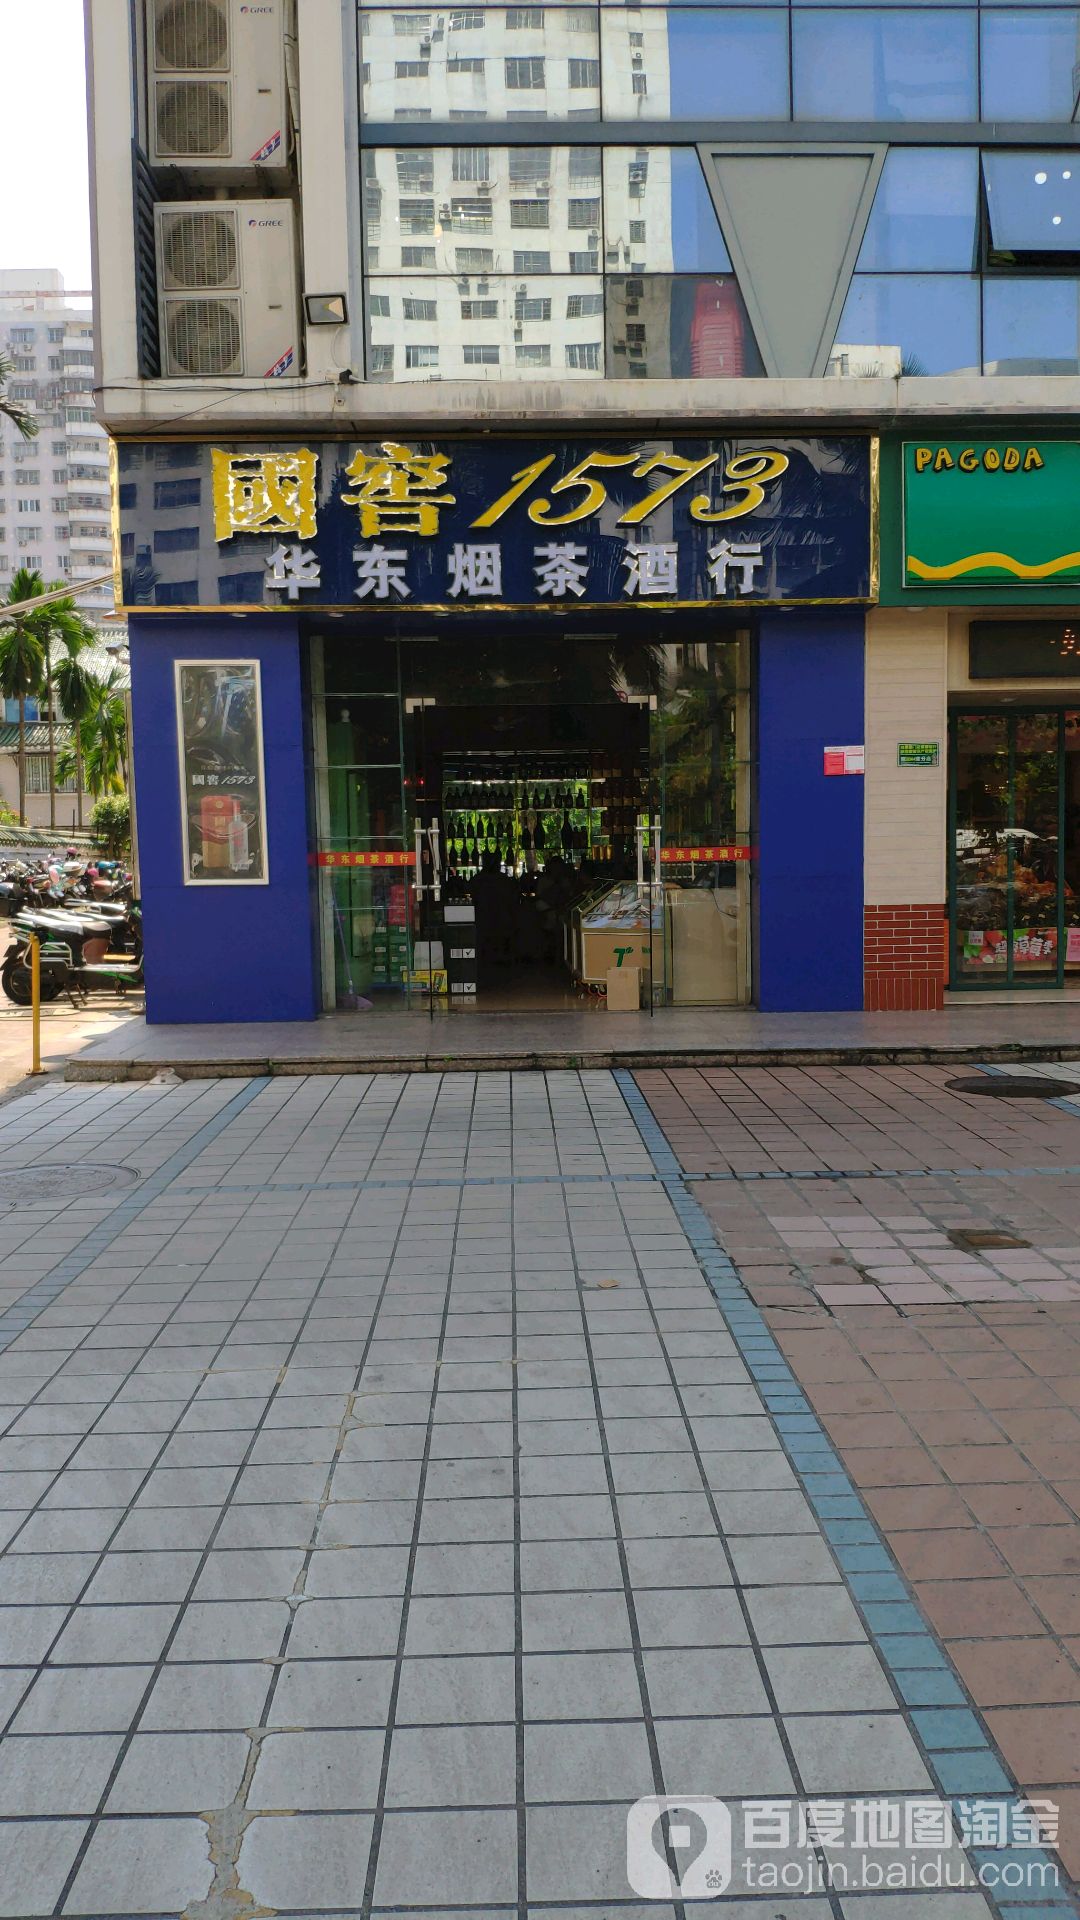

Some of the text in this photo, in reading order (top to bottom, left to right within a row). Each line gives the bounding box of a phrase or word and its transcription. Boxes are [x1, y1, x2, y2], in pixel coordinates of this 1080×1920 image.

[914, 446, 1045, 473] PAGODA
[265, 540, 763, 600] 华东烟茶酒行
[325, 854, 409, 864] 华东烟茶酒行
[661, 848, 744, 860] 华东烟茶酒行
